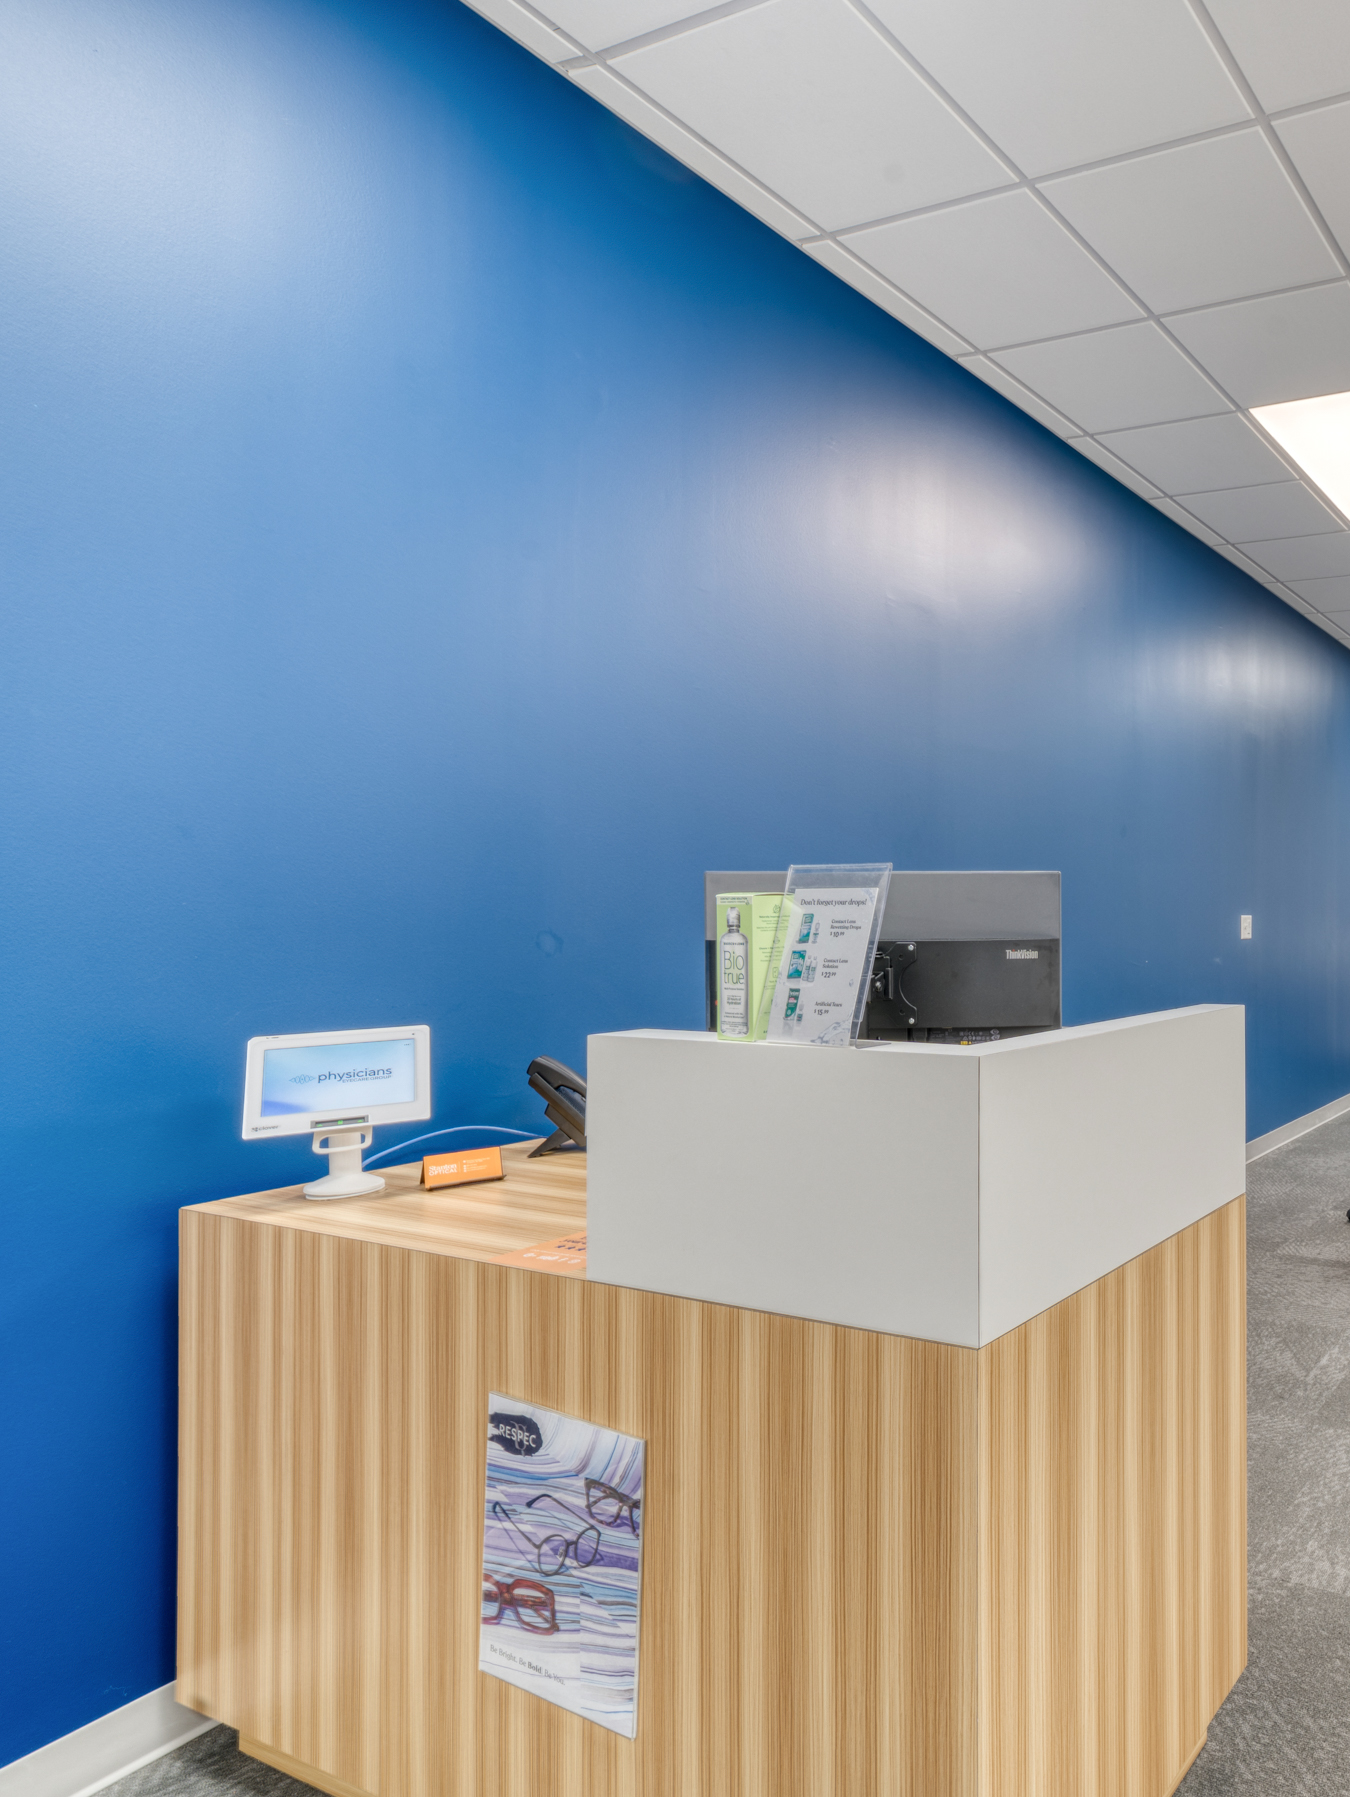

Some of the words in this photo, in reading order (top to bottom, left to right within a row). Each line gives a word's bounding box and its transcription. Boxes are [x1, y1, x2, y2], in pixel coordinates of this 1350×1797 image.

[816, 899, 833, 907] forget
[848, 899, 867, 907] drops!
[723, 951, 745, 970] Bio
[1005, 949, 1039, 960] ThinkVision
[723, 970, 745, 984] true
[317, 1067, 393, 1084] physicians
[428, 1163, 457, 1172] Stanton
[428, 1168, 458, 1176] OPTICAL
[499, 1423, 537, 1448] RESPEC
[490, 1644, 497, 1654] Be
[518, 1657, 527, 1667] Be
[544, 1669, 552, 1679] Be
